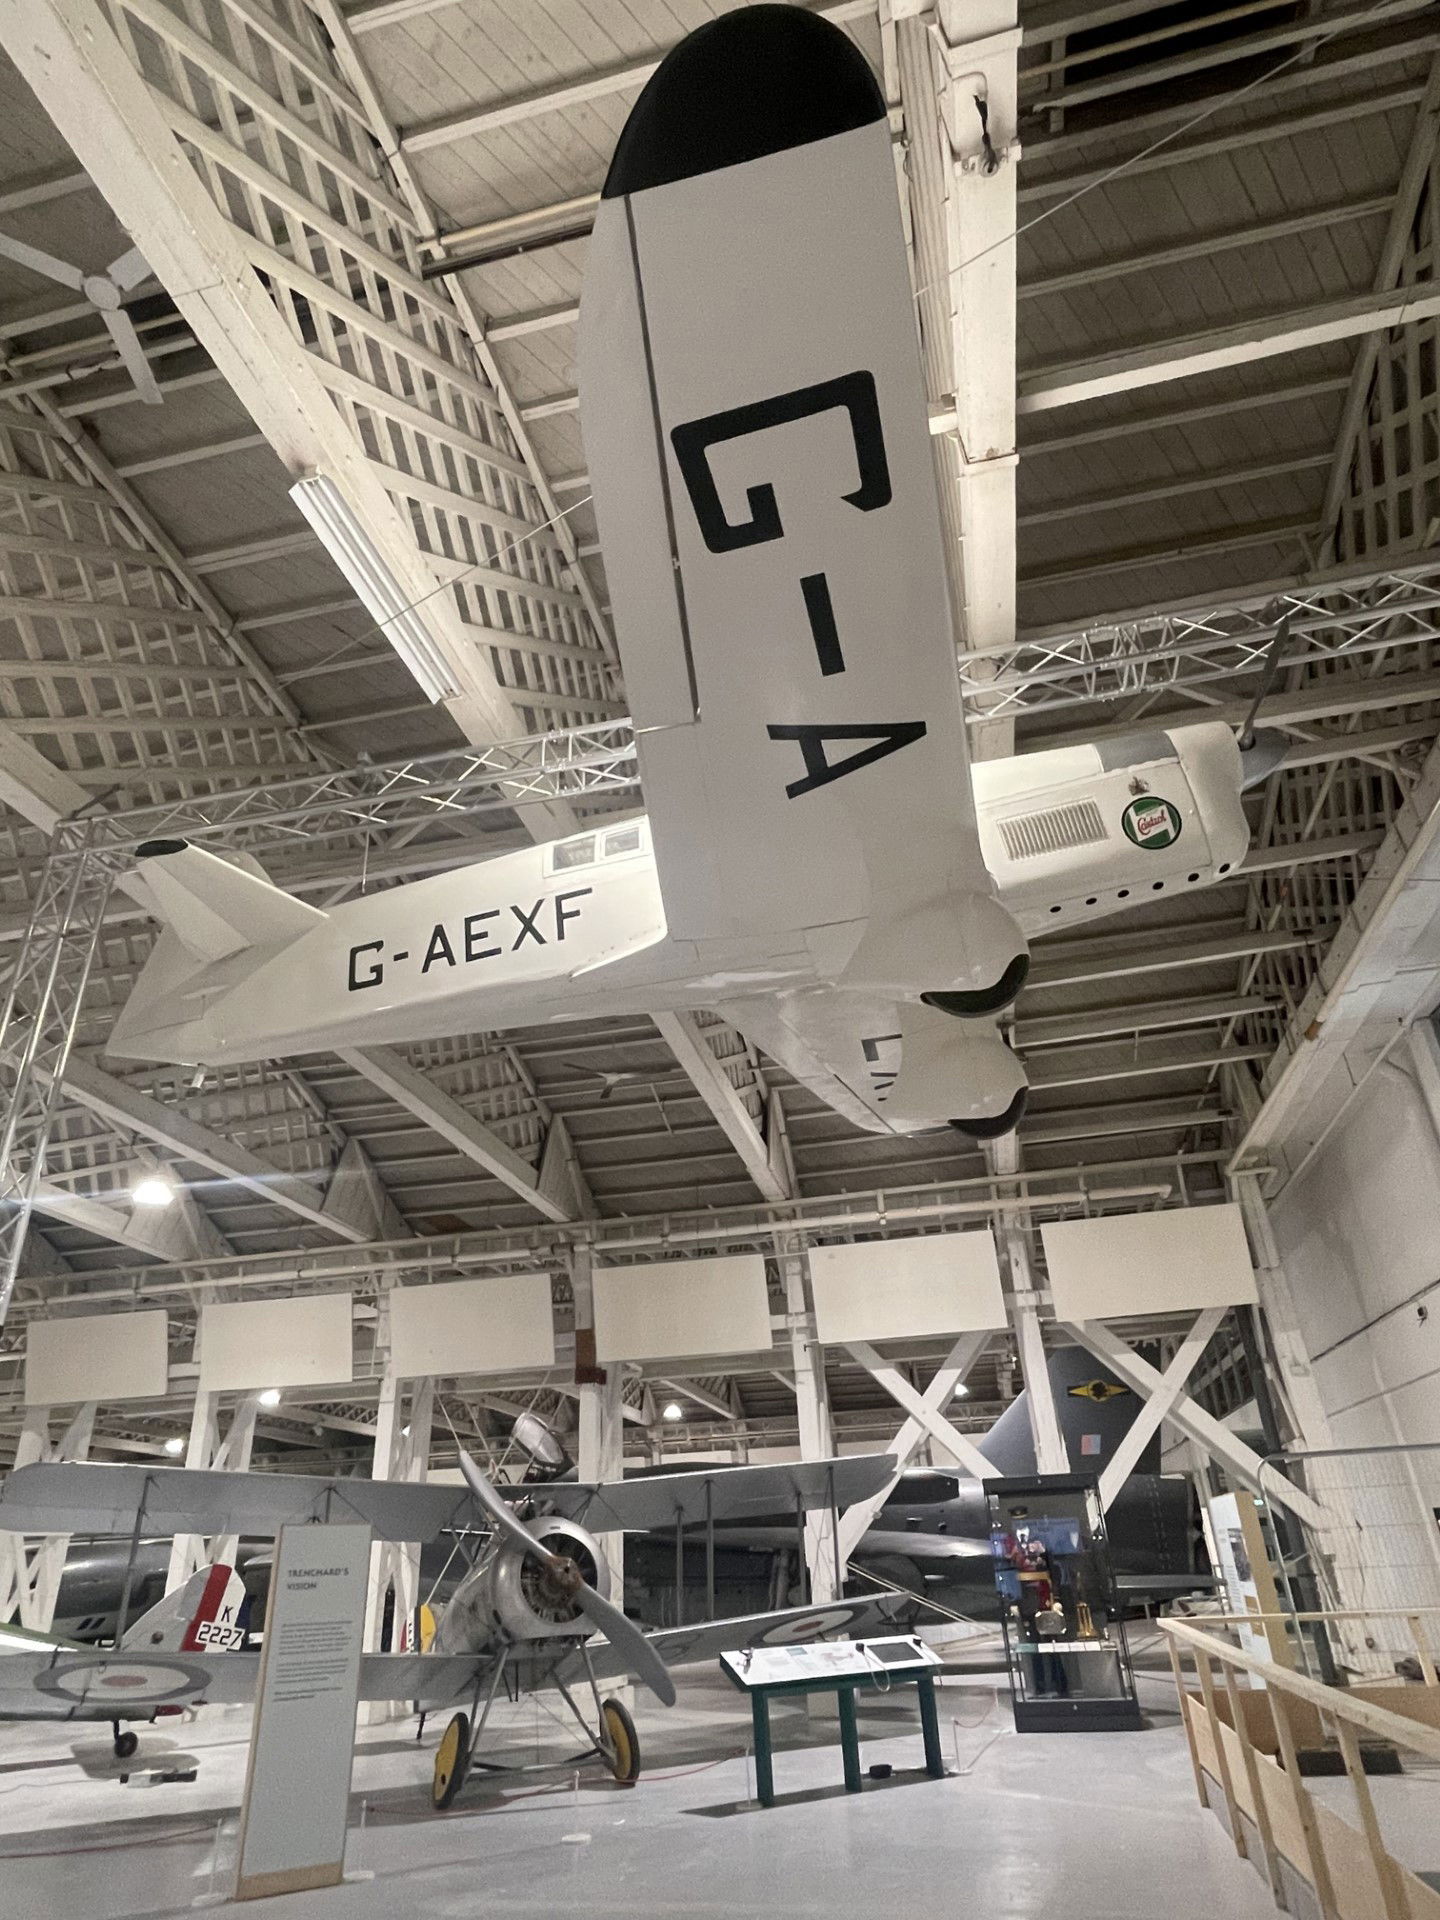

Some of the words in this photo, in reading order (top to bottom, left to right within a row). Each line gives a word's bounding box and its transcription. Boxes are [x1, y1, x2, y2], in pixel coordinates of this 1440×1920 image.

[670, 370, 927, 800] G-A
[1137, 809, 1167, 835] Castrol
[348, 887, 593, 991] G-AEXF
[287, 1567, 350, 1577] TRENCHARD'S
[286, 1582, 317, 1590] VISION
[221, 1605, 234, 1622] K
[198, 1624, 243, 1647] 2227
